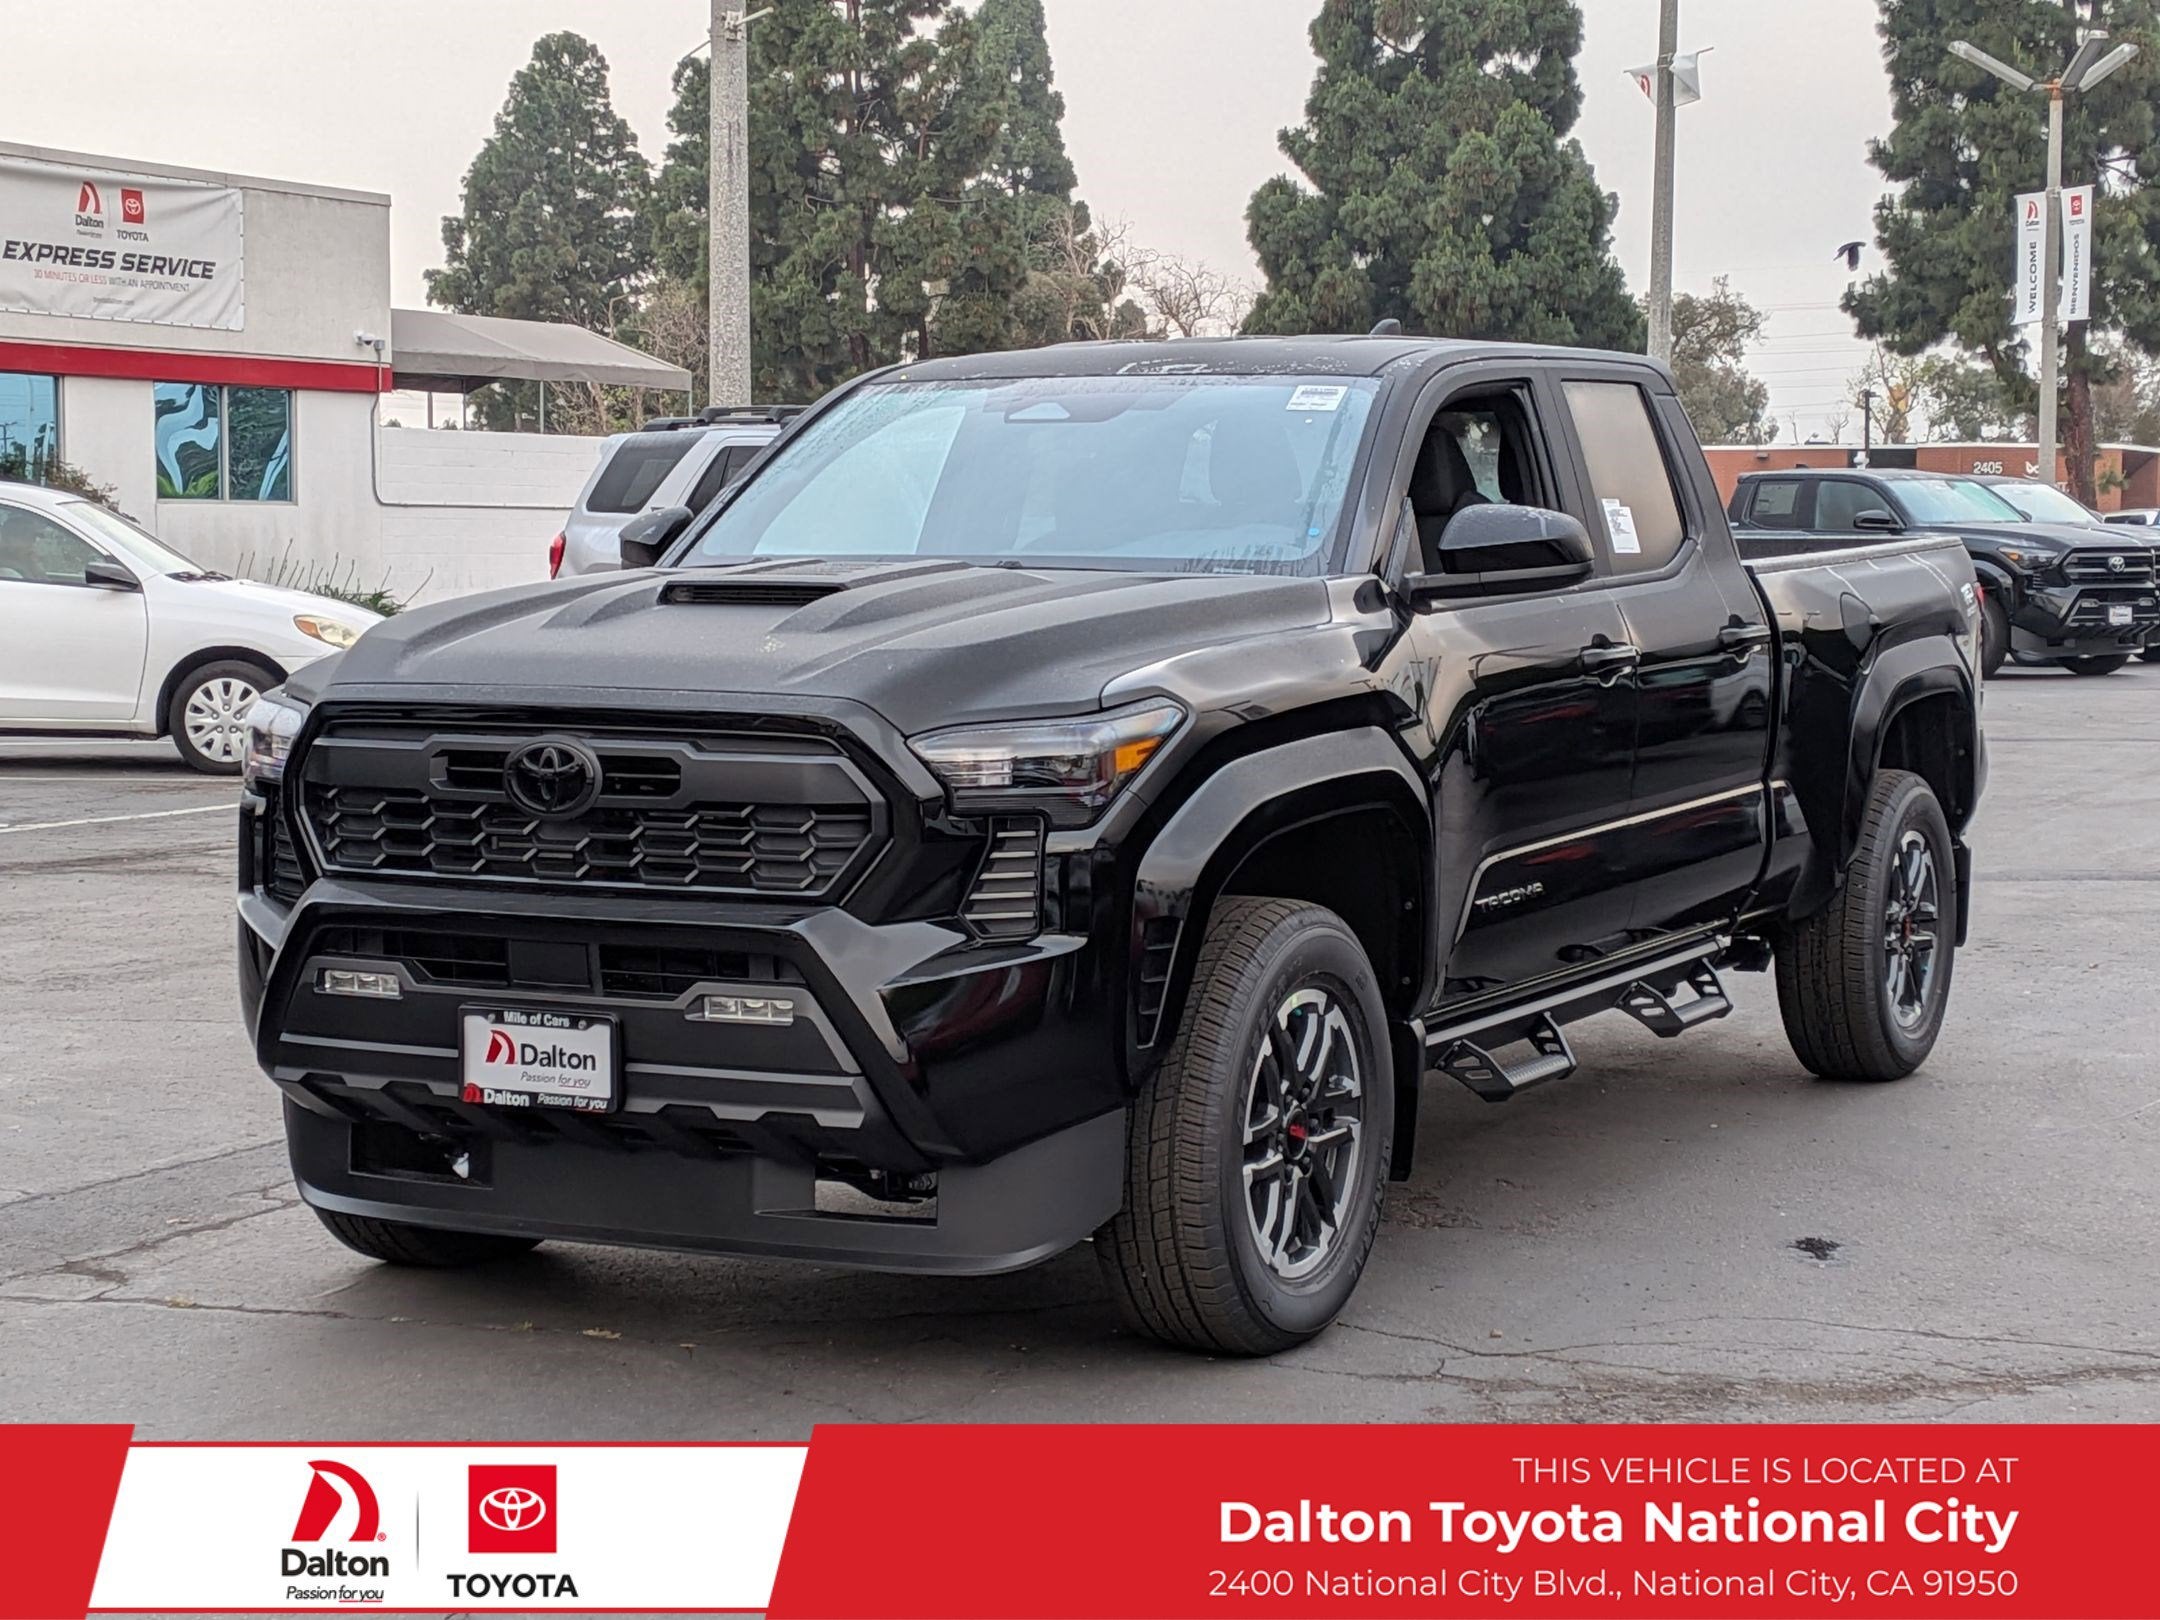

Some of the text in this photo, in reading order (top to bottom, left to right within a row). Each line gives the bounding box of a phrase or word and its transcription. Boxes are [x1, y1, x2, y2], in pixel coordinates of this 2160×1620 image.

[75, 214, 104, 229] Dalton
[116, 229, 149, 242] TOYOTA
[2, 240, 216, 280] EXPRESS SERVICE
[44, 270, 77, 282] MINUTES
[91, 274, 108, 285] LESS
[140, 279, 190, 292] APPOINTMENT
[2029, 241, 2037, 314] WELCOME
[2070, 233, 2080, 315] BIENVENIDOS
[1973, 461, 2004, 475] 2405
[503, 1011, 570, 1028] Mile of Cars
[520, 1043, 596, 1071] Dalton
[520, 1071, 591, 1089] Passion for you
[483, 1089, 608, 1112] Dalton Passion for you
